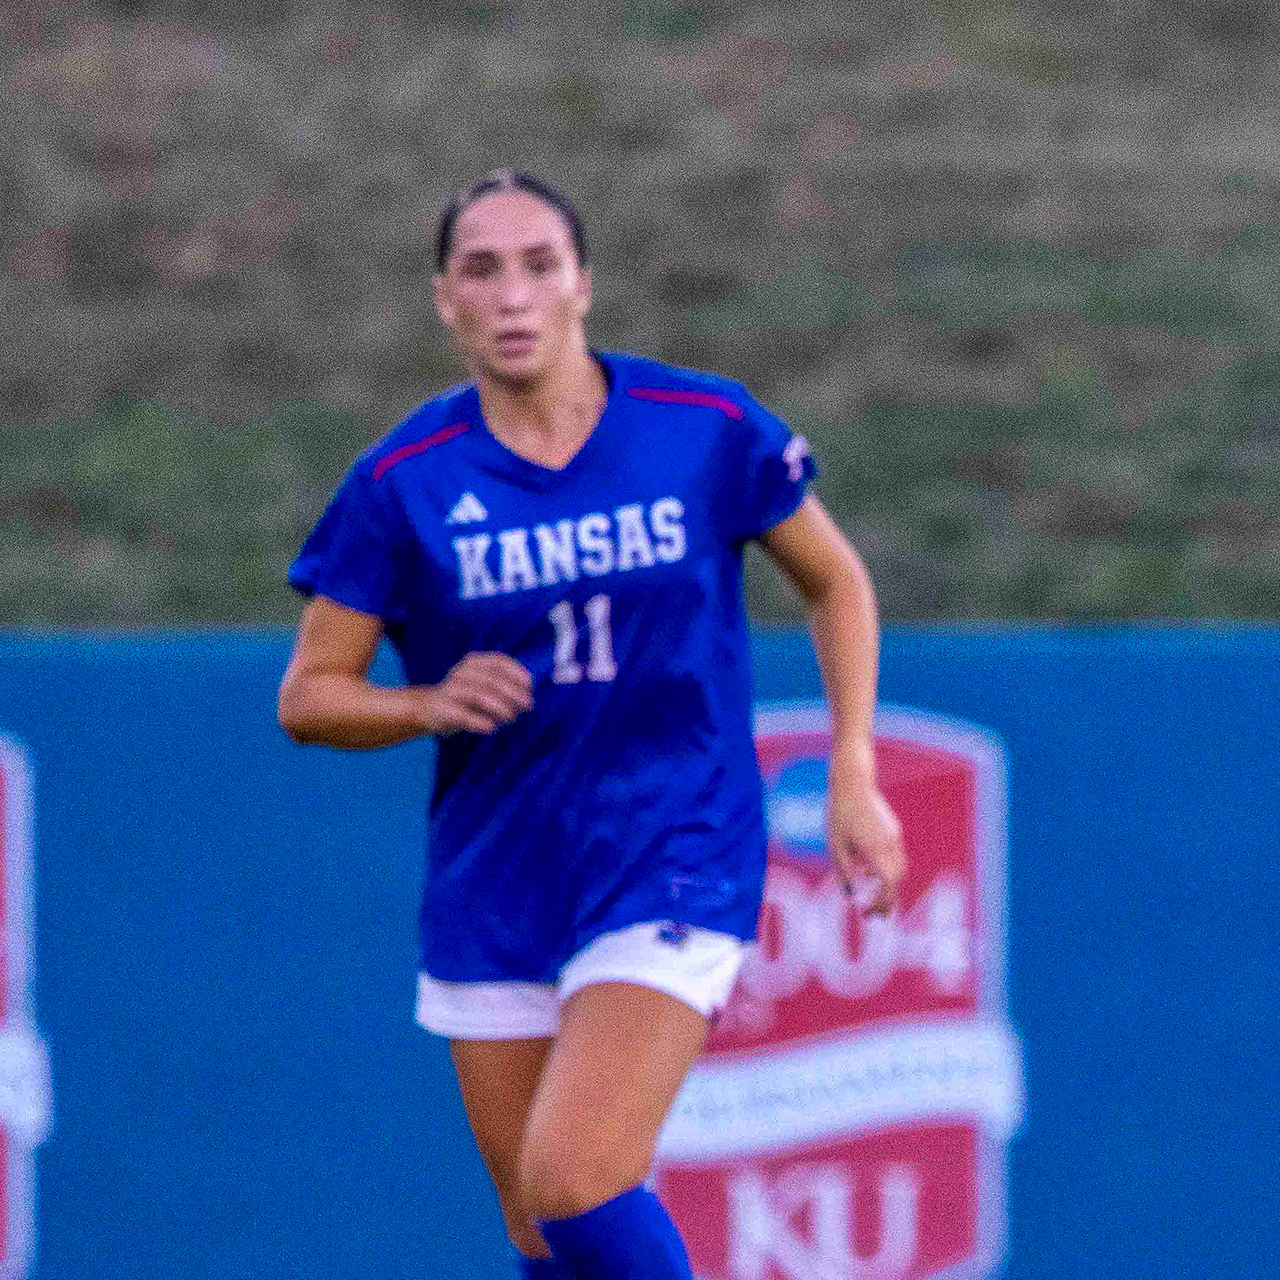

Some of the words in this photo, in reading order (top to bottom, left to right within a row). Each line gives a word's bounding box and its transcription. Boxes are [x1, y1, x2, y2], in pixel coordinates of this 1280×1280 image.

[452, 496, 687, 600] KANSAS
[550, 594, 617, 684] 11
[752, 864, 974, 998] 004
